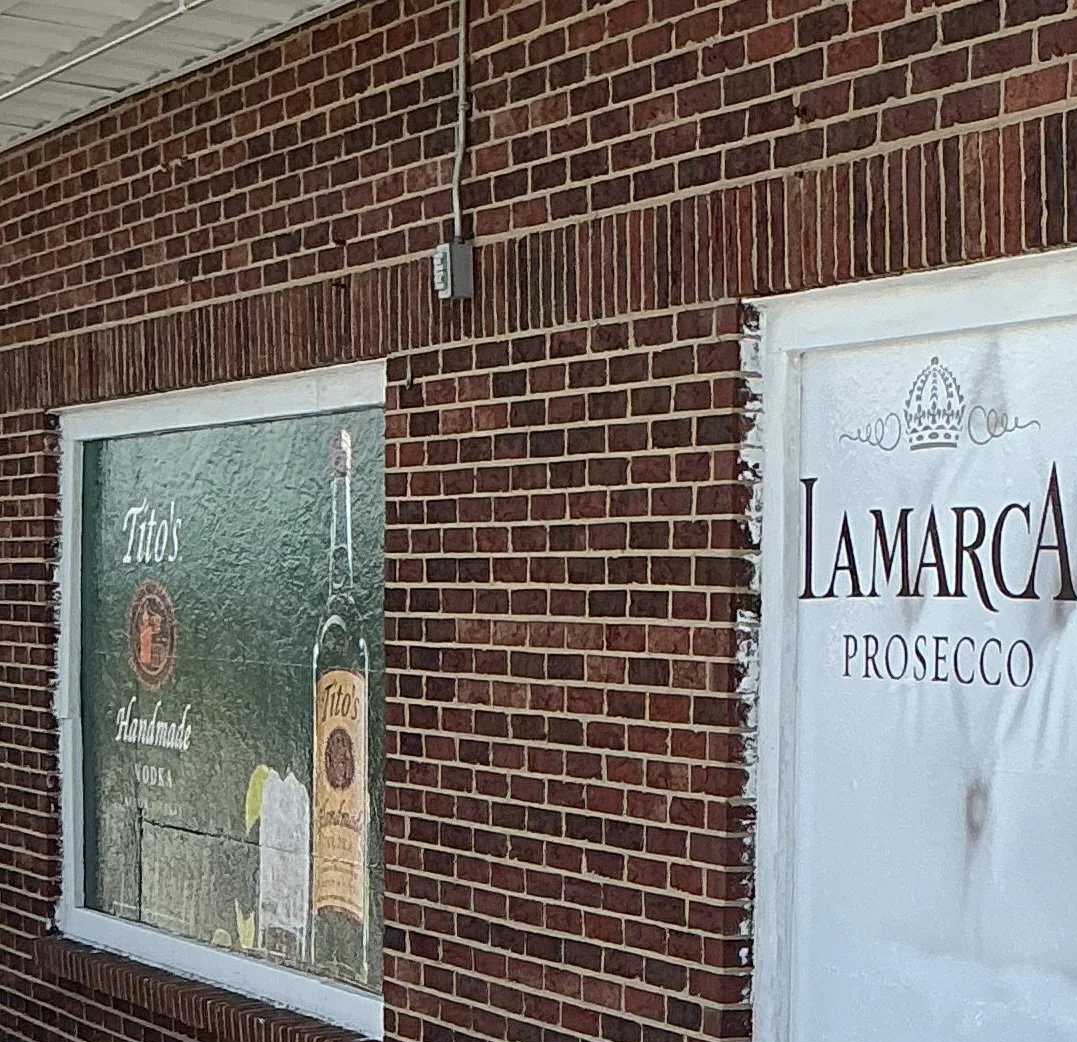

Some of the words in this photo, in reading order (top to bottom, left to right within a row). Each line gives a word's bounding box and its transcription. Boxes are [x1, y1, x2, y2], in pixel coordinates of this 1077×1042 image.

[122, 499, 182, 564] Tito's
[843, 633, 1034, 688] PROSECCO
[115, 695, 192, 752] Handmade
[320, 679, 361, 723] Tito's
[134, 763, 173, 789] VODKA
